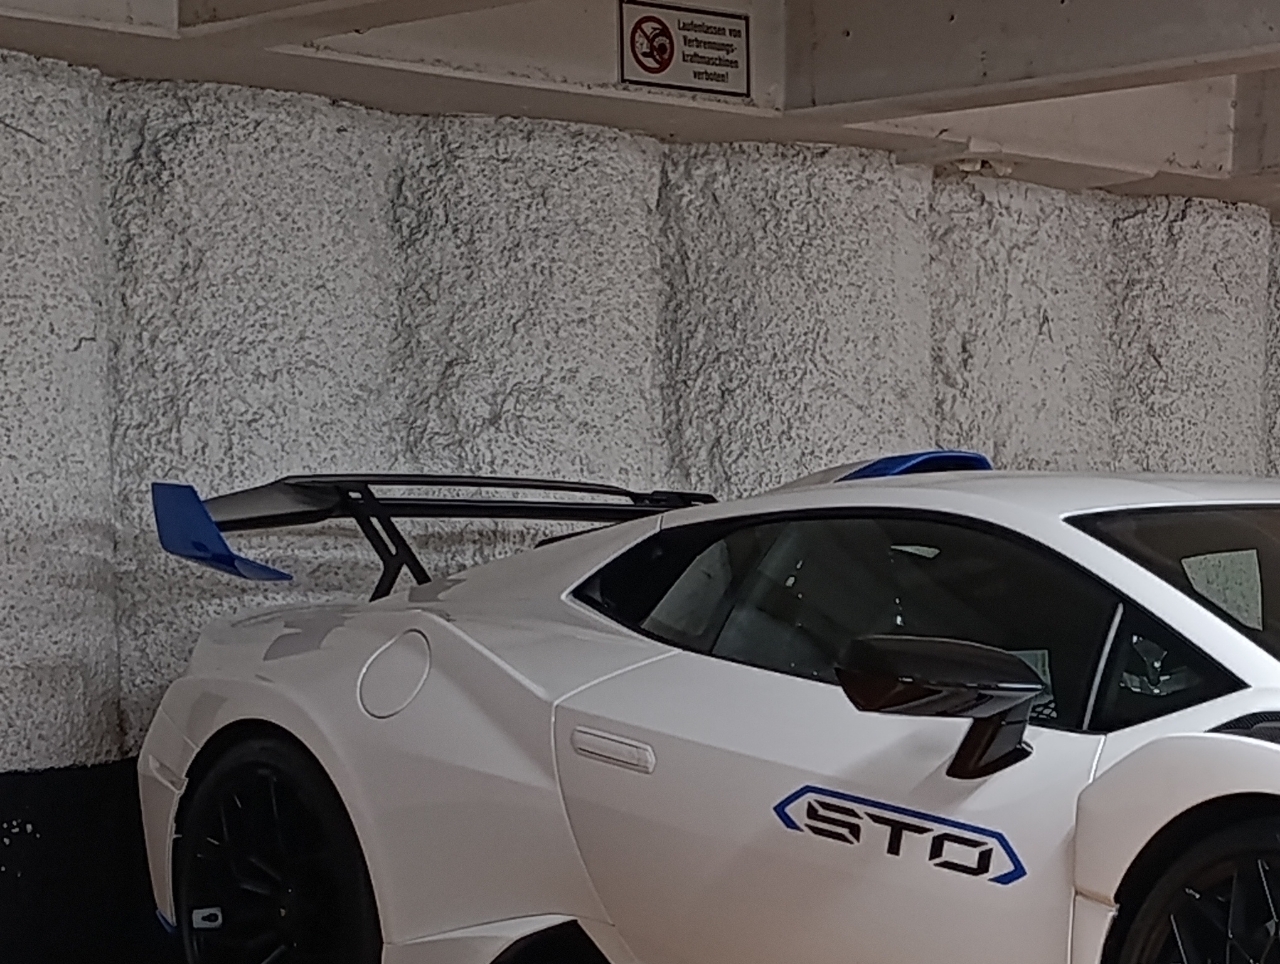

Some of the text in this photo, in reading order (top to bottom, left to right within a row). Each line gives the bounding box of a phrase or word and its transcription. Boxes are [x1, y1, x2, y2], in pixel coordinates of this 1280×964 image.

[677, 19, 742, 38] Laufenlassen von
[692, 69, 729, 83] verboten!
[804, 799, 994, 877] STO
